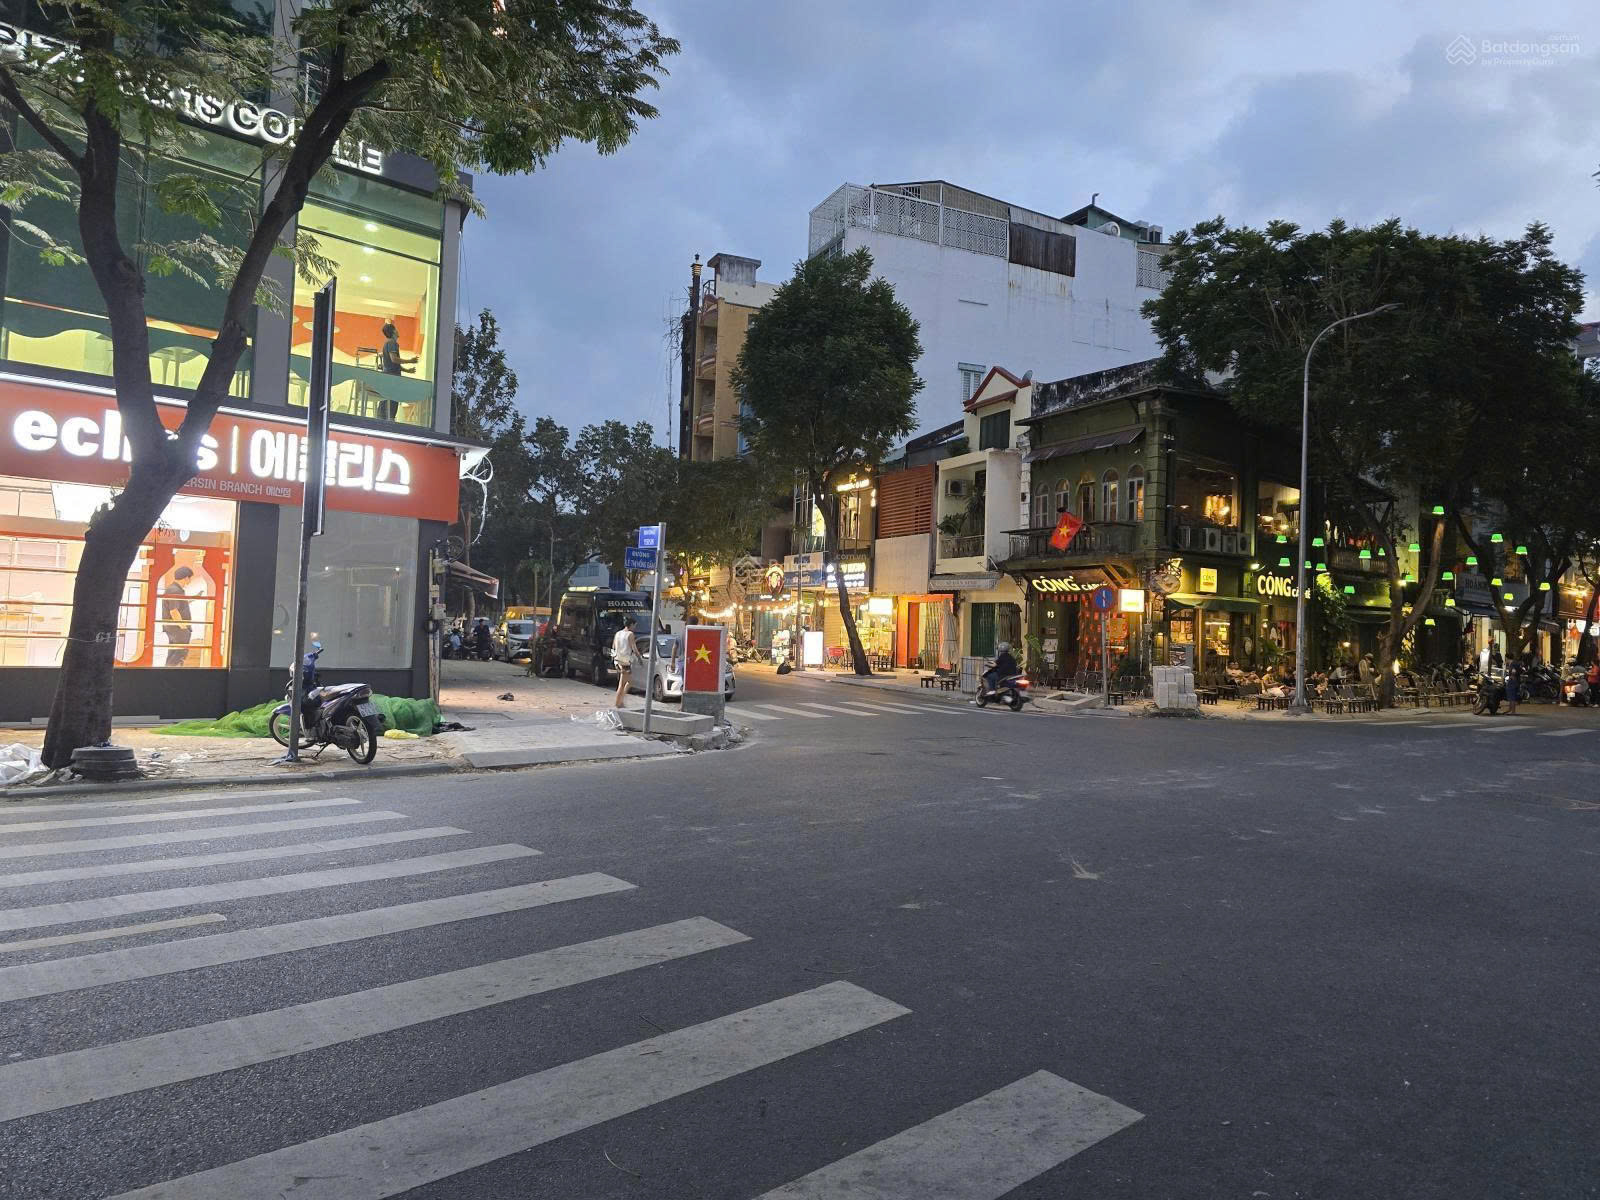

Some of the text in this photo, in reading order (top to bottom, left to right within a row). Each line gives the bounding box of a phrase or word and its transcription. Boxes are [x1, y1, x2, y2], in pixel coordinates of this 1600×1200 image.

[13, 410, 219, 470] ecls
[183, 477, 217, 490] ERSIN
[219, 480, 263, 495] BRANCH
[1031, 576, 1081, 594] CỘNG
[1257, 571, 1292, 600] CỘNG
[1047, 611, 1055, 619] 93
